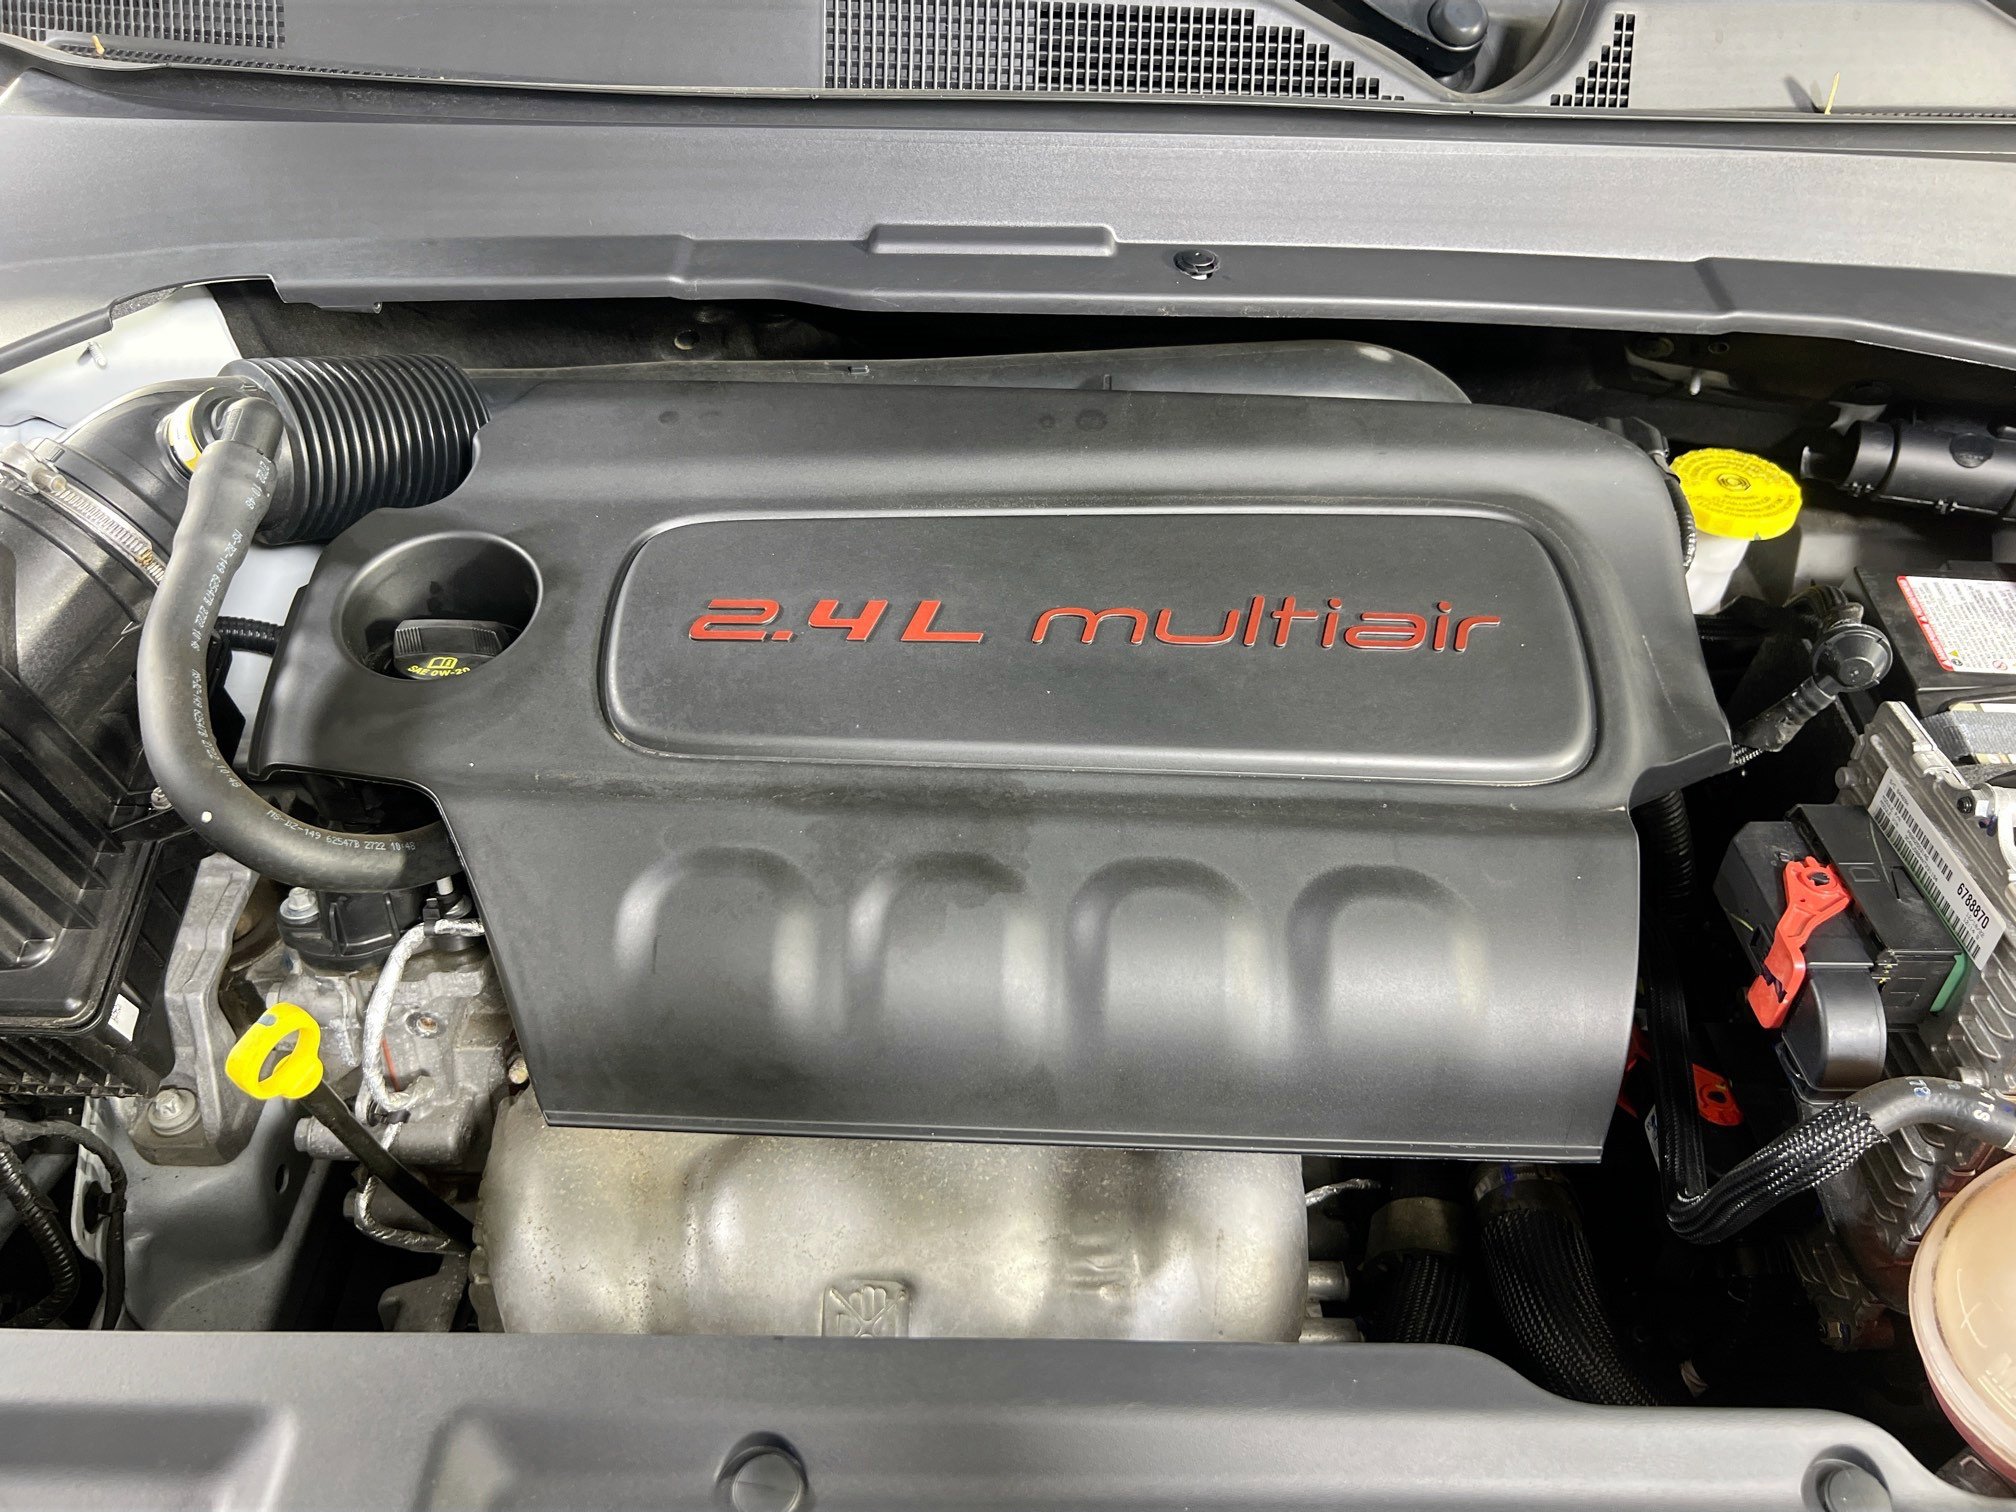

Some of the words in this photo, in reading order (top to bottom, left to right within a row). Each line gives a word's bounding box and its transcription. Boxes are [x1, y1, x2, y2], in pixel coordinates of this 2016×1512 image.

[1031, 595, 1500, 652] multiair
[407, 664, 430, 676] SAE
[364, 841, 387, 851] 2722
[1957, 883, 1991, 930] 6788870
